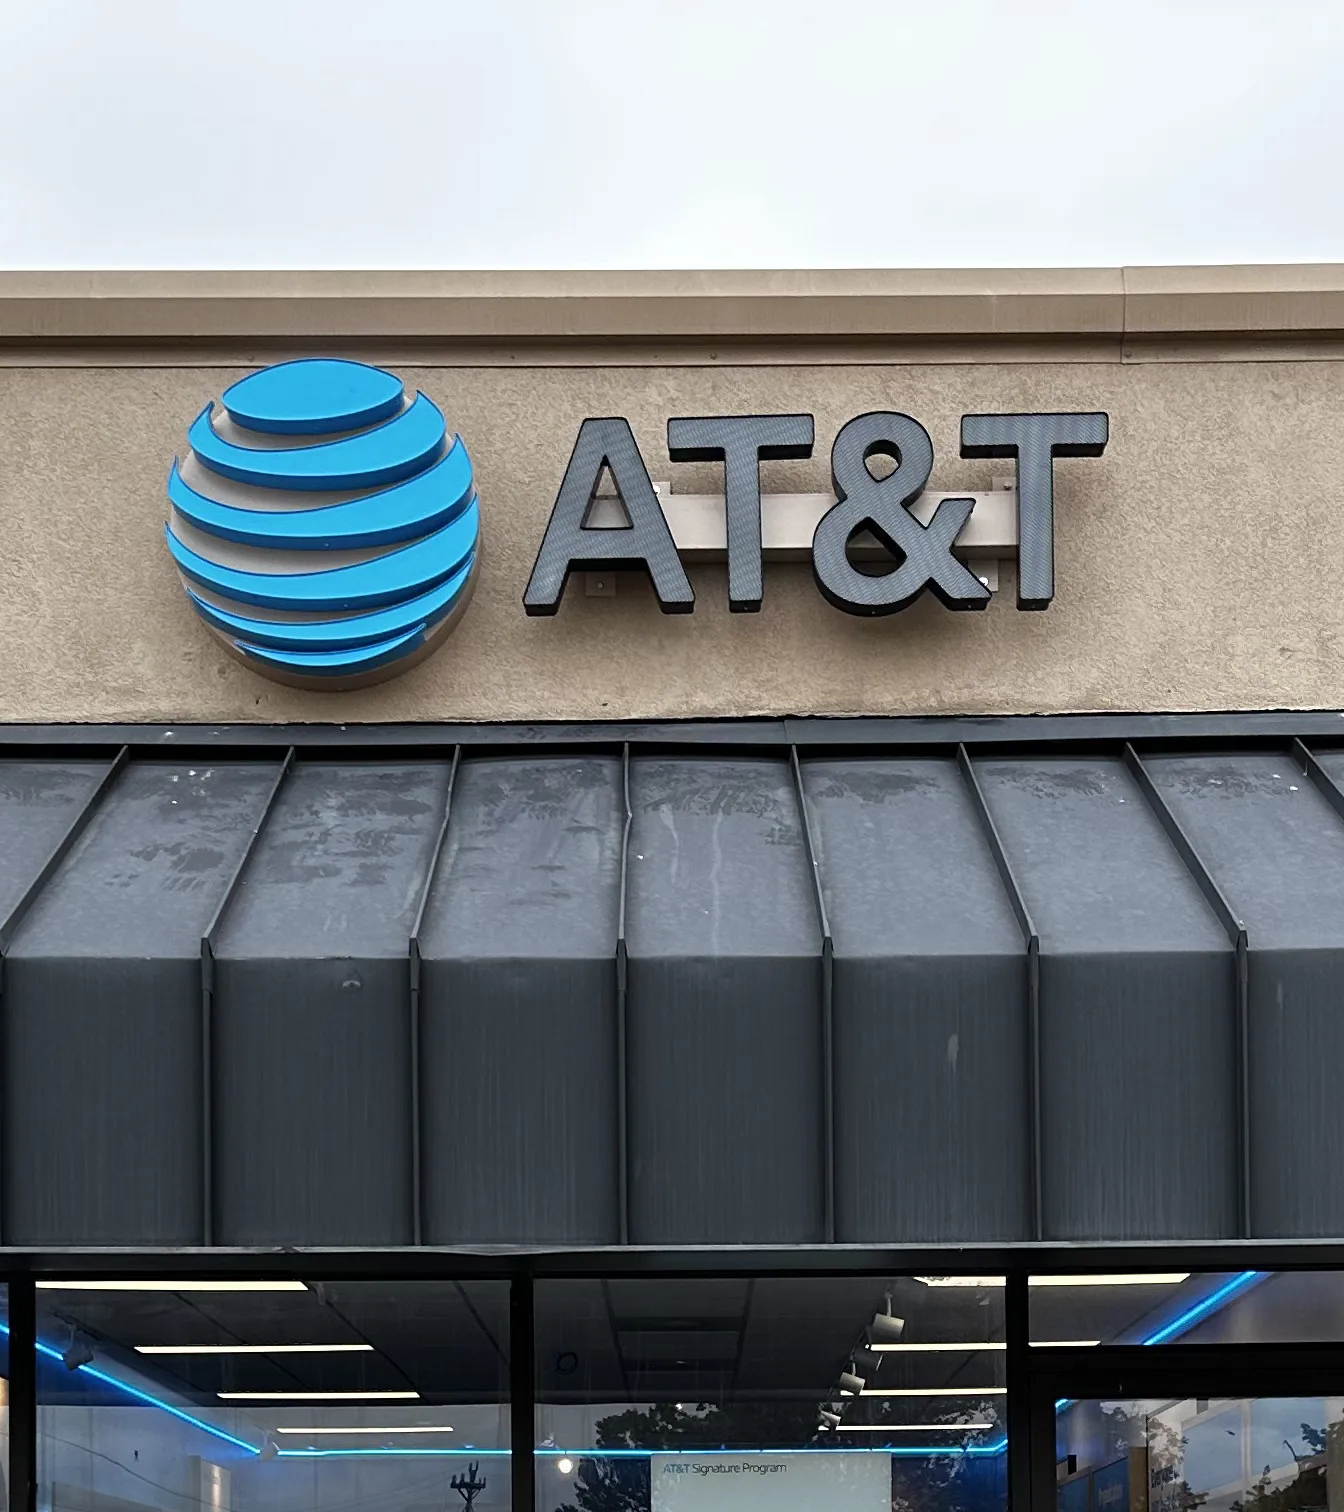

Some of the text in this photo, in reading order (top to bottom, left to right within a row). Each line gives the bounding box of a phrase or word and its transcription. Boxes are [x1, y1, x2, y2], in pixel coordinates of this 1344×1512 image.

[523, 411, 1109, 617] AT&T
[663, 1463, 787, 1476] AT&T Signature Program
